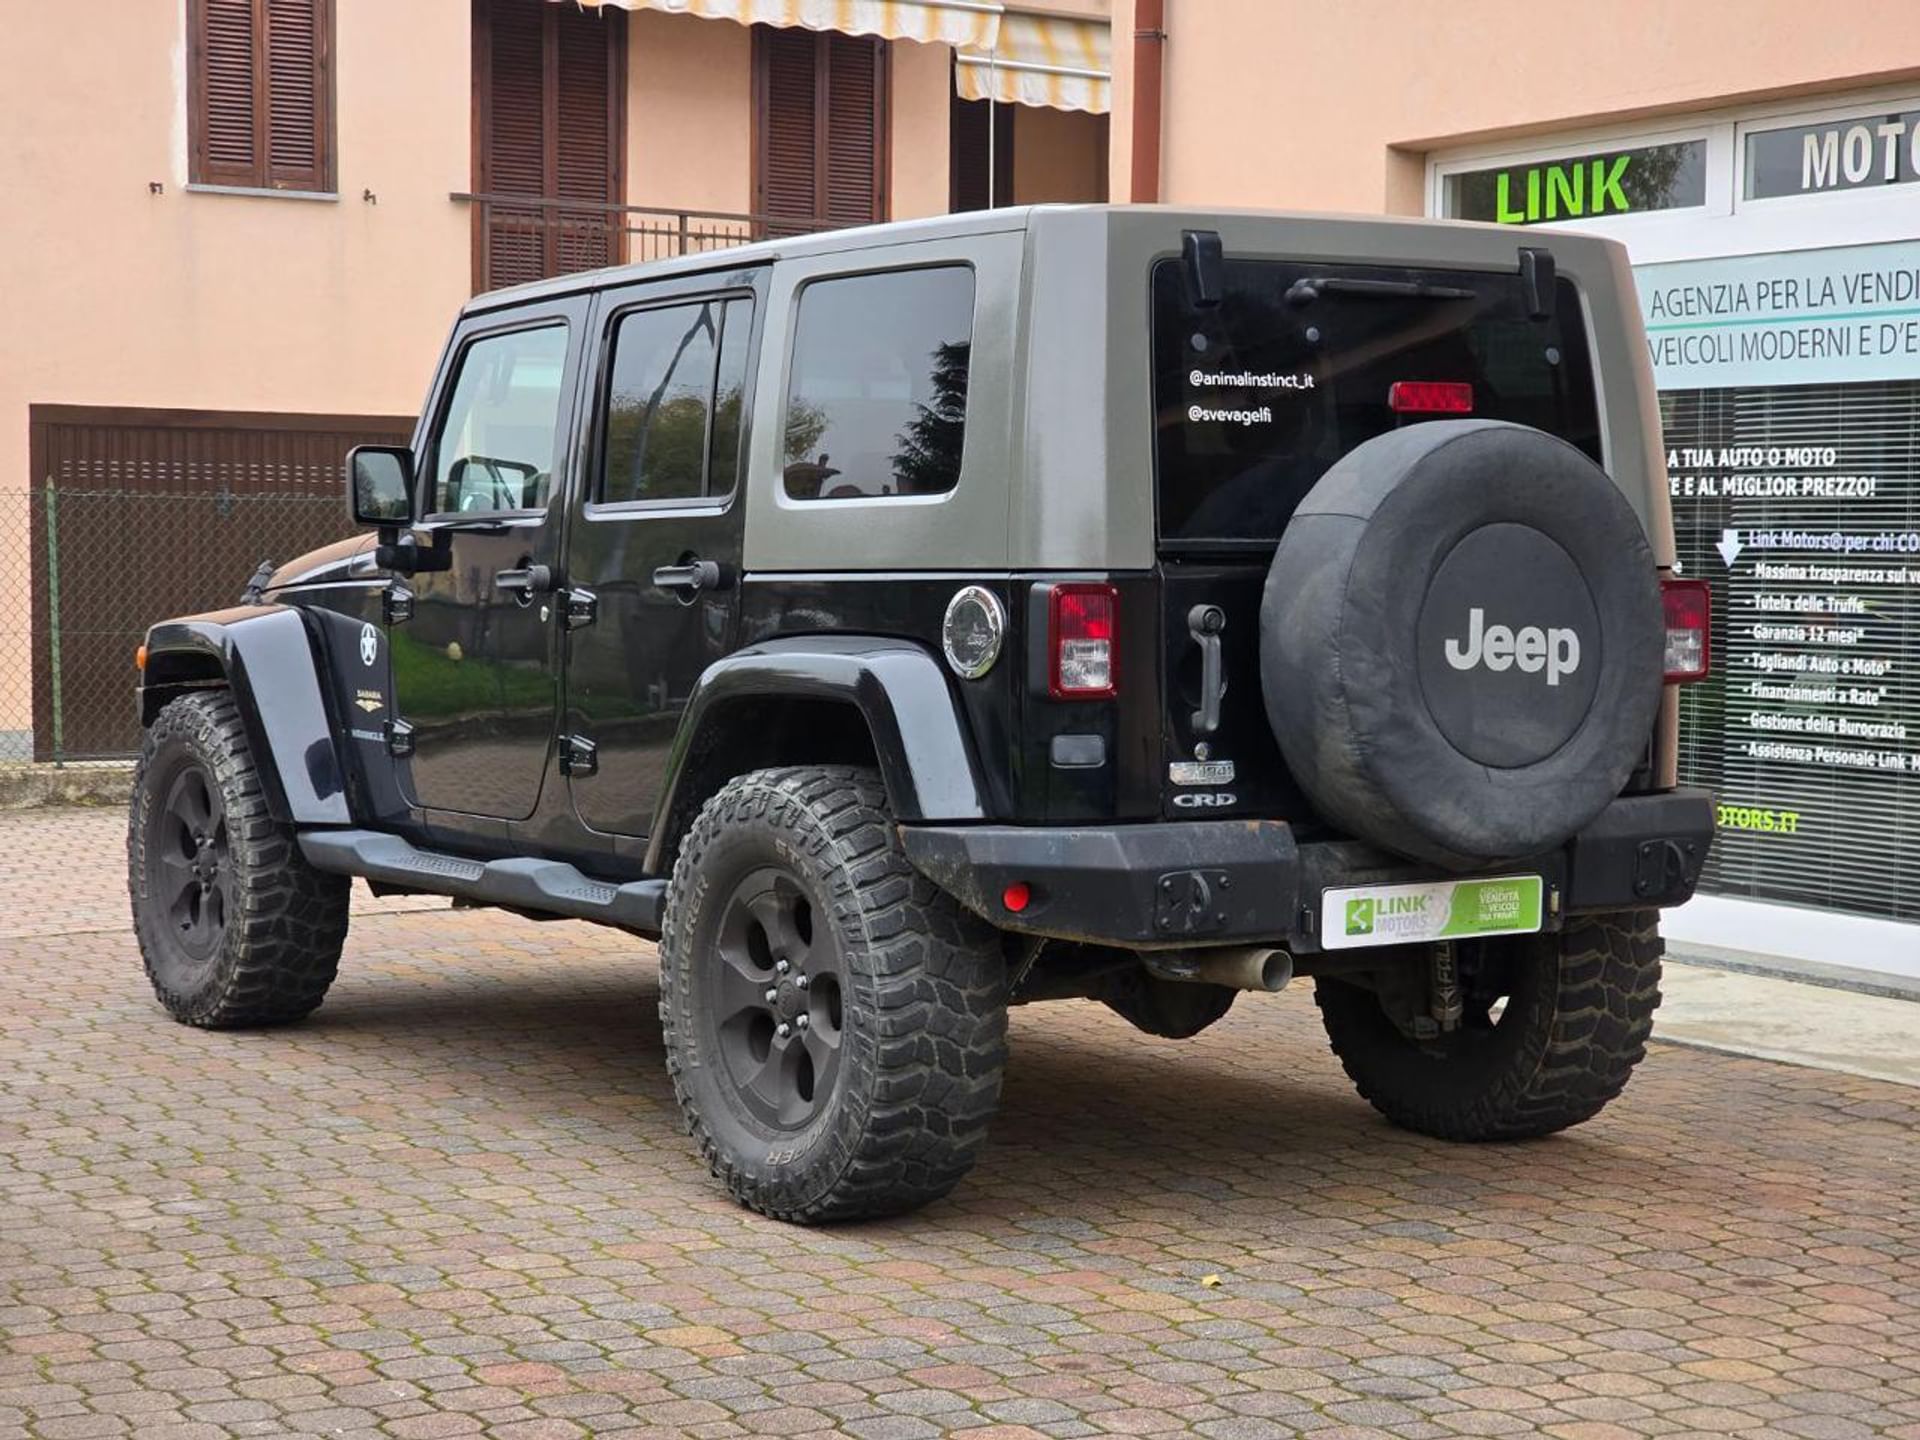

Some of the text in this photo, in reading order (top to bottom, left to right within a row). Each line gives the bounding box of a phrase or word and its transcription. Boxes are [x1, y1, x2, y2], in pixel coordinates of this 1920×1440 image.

[1801, 121, 1920, 189] MOT
[1496, 154, 1631, 224] LINK
[1651, 269, 1920, 319] AGENZIA PER LA VENDI
[1648, 321, 1918, 366] VEICOLI MODERNI E D'E
[1189, 370, 1315, 389] @animalinstinct_it
[1188, 406, 1272, 425] @svevagelfi
[1682, 448, 1714, 468] TUA
[1718, 448, 1763, 467] AUTO
[1768, 448, 1780, 467] O
[1785, 447, 1836, 467] MOTO
[1684, 477, 1695, 496] E
[1699, 477, 1718, 496] AL
[1722, 476, 1798, 497] MIGLIOR
[1802, 476, 1876, 497] PREZZO!
[1749, 529, 1779, 548] Link
[1845, 535, 1869, 554] per
[1873, 532, 1895, 551] chi
[1755, 562, 1807, 579] Massima
[1809, 564, 1884, 584] trasparenza
[1887, 566, 1906, 583] sul
[1754, 592, 1791, 611] Tutela
[1826, 595, 1865, 613] Truffe
[1753, 624, 1805, 641] Garanzia
[1808, 626, 1824, 642] 12
[1445, 608, 1580, 685] Jeep
[1752, 653, 1807, 672] Tagliandi
[1810, 656, 1839, 672] Auto
[1842, 660, 1850, 673] e
[1751, 682, 1836, 702] Finanziamenti
[1838, 690, 1846, 703] a
[1750, 712, 1906, 739] Gestione della Burocrazia
[1748, 742, 1813, 762] Assistenza
[1815, 747, 1875, 767] Personale
[1878, 751, 1906, 769] Link
[1174, 793, 1237, 807] CRD
